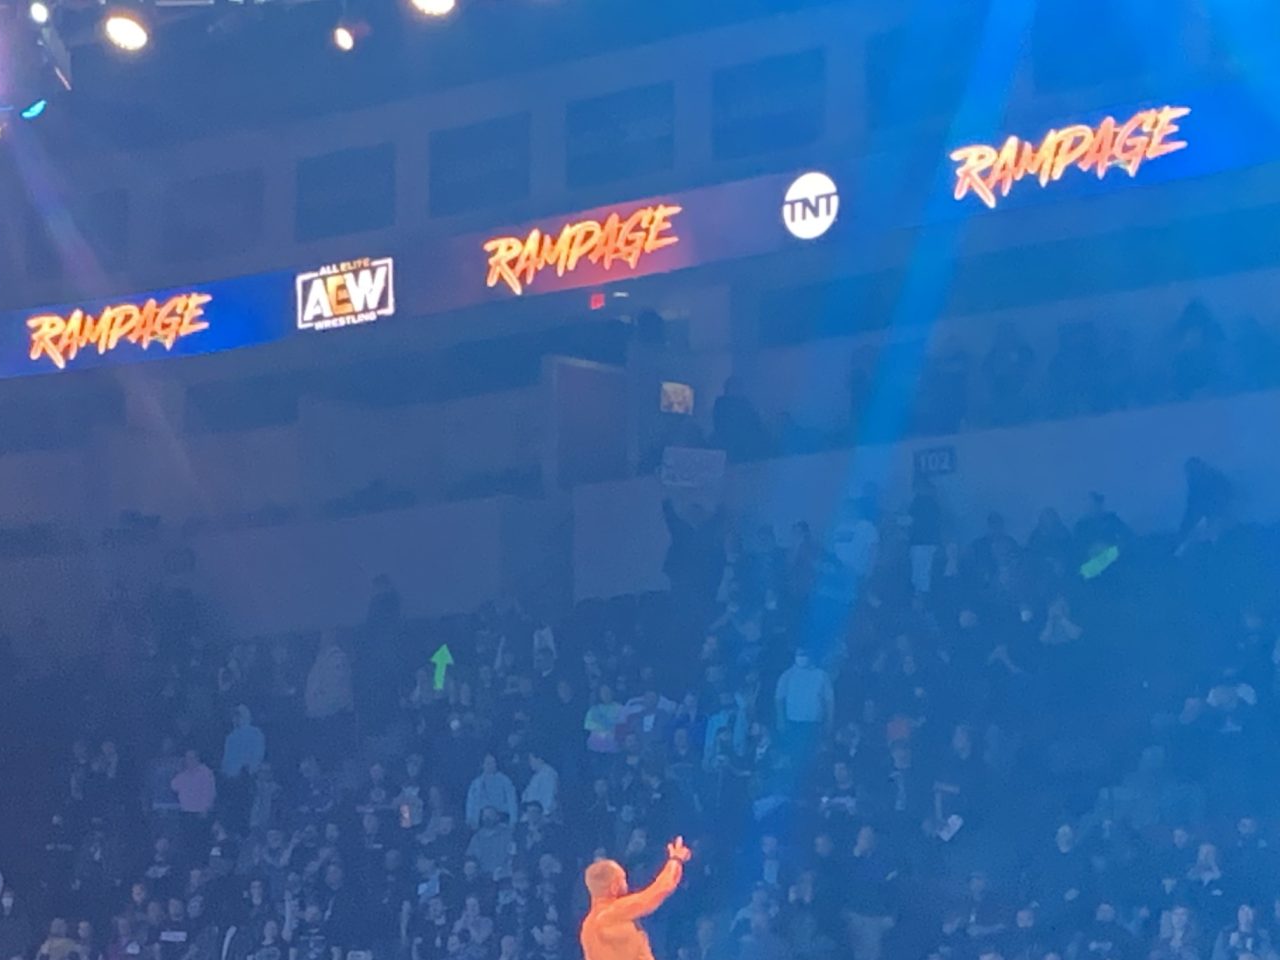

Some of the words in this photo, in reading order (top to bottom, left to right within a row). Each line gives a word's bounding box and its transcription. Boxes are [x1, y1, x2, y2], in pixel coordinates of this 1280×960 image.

[950, 105, 1190, 208] RAMPAGE
[784, 192, 838, 222] TNT
[319, 264, 339, 275] ALL
[340, 257, 370, 272] ELITE
[483, 203, 682, 294] RAMPAGE
[303, 265, 388, 322] AEW
[26, 292, 212, 369] RAMPAGE
